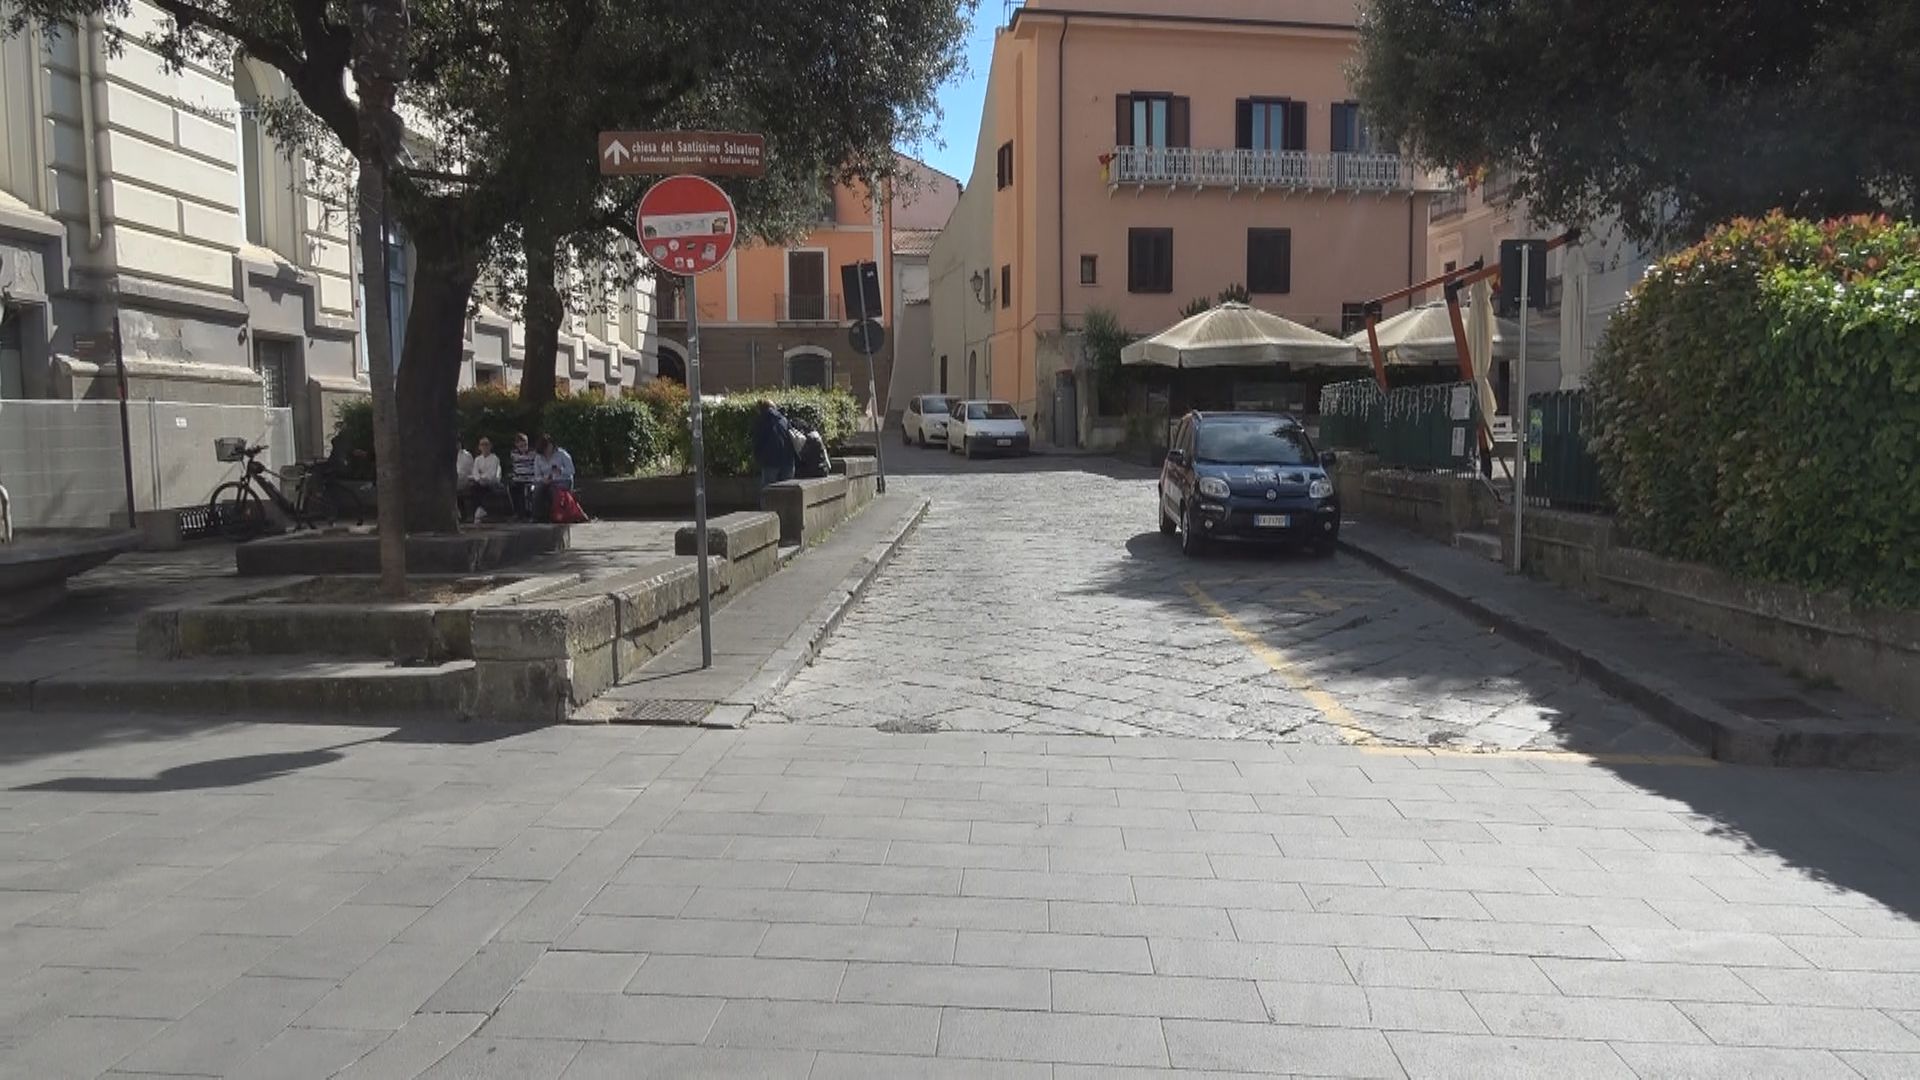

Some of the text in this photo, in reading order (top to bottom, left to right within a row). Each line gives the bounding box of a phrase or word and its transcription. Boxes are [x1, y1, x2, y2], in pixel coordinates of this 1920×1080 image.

[632, 141, 760, 156] chiesa del Santissimo Salvatore
